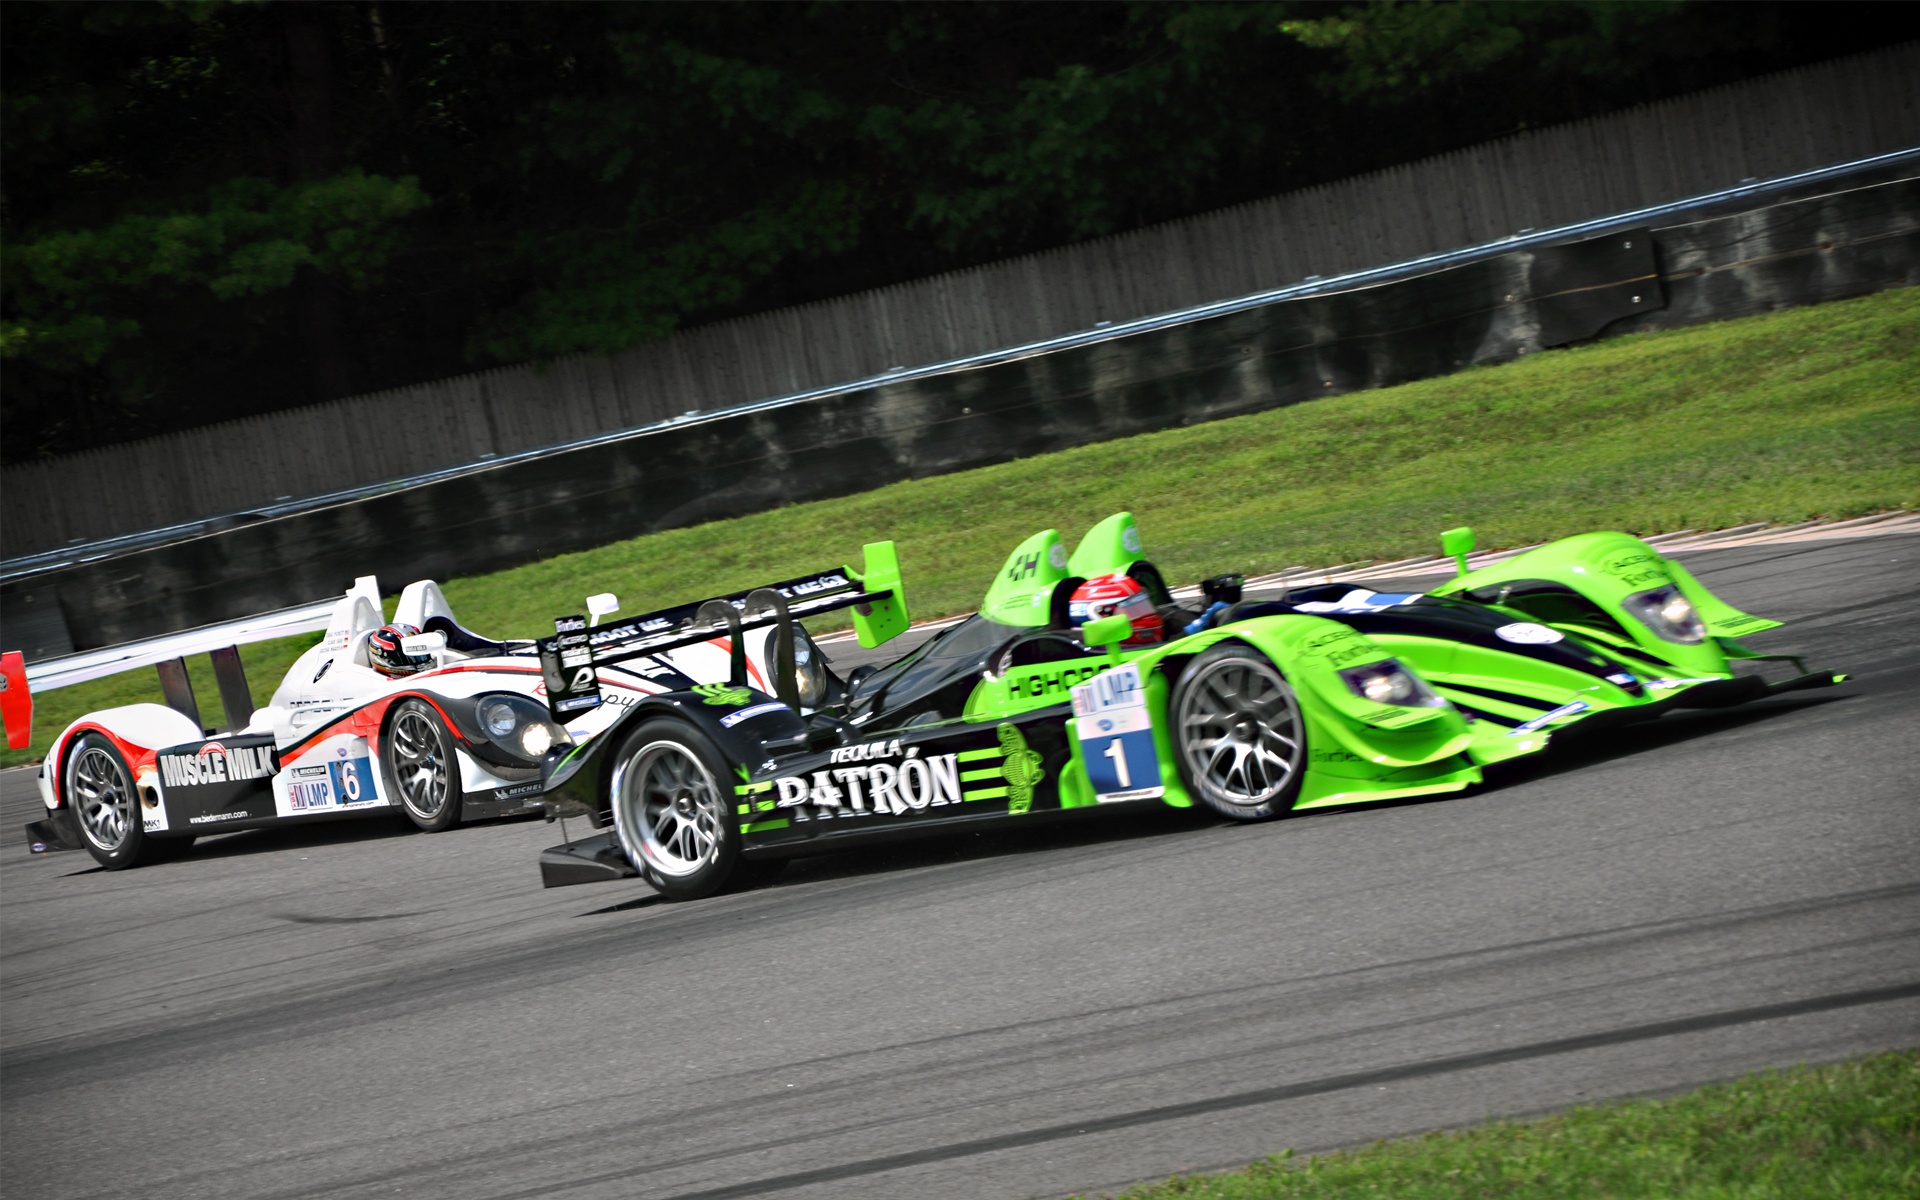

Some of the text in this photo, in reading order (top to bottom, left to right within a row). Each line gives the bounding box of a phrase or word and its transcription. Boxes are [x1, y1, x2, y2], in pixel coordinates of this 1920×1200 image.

[160, 752, 227, 787] MUSCLE
[226, 745, 279, 781] MILK
[830, 739, 904, 764] TEQUILA
[1104, 738, 1132, 788] 1
[305, 782, 329, 807] LMP
[342, 761, 360, 801] 6
[509, 783, 543, 795] MICHEL
[775, 747, 963, 821] PATRÓN
[189, 810, 248, 824] www.biedermann.com
